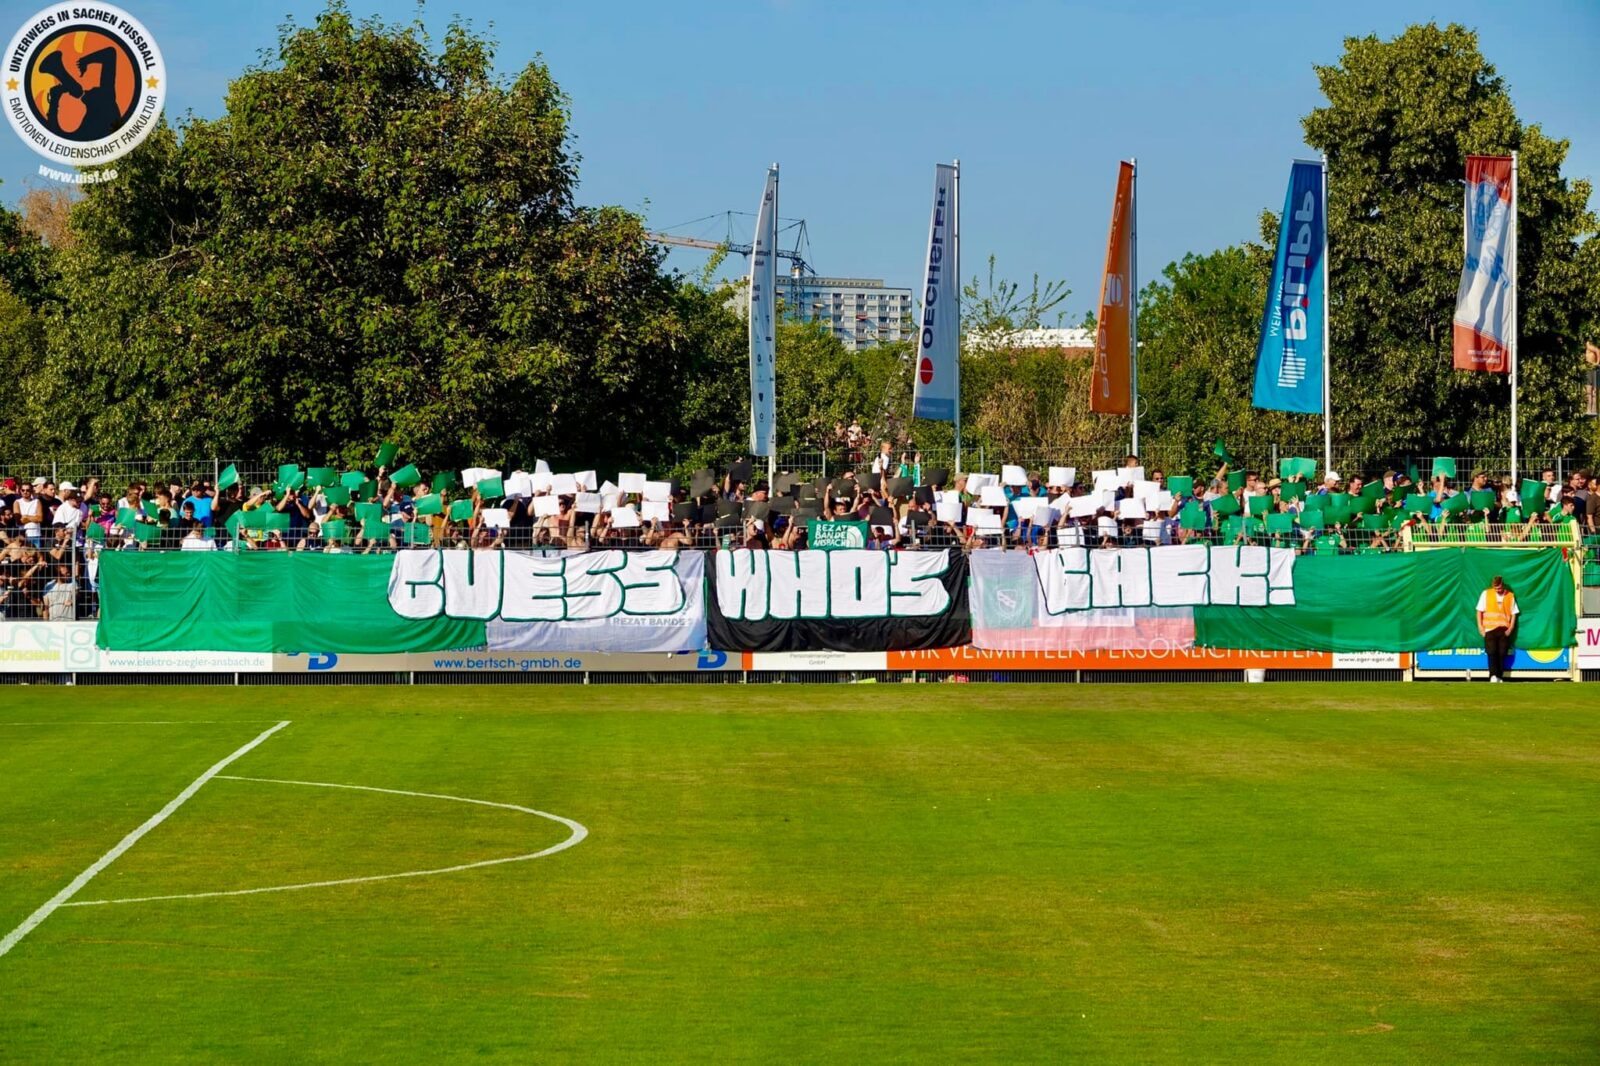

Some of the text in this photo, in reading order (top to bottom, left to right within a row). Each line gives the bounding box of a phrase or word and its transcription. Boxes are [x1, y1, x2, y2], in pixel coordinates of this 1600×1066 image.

[388, 549, 686, 622] GUESS
[716, 549, 950, 621] WHO'S
[109, 656, 265, 669] www.elektro-ziegler-ansbach.de
[433, 658, 581, 671] www.bertsch-gmbh.de
